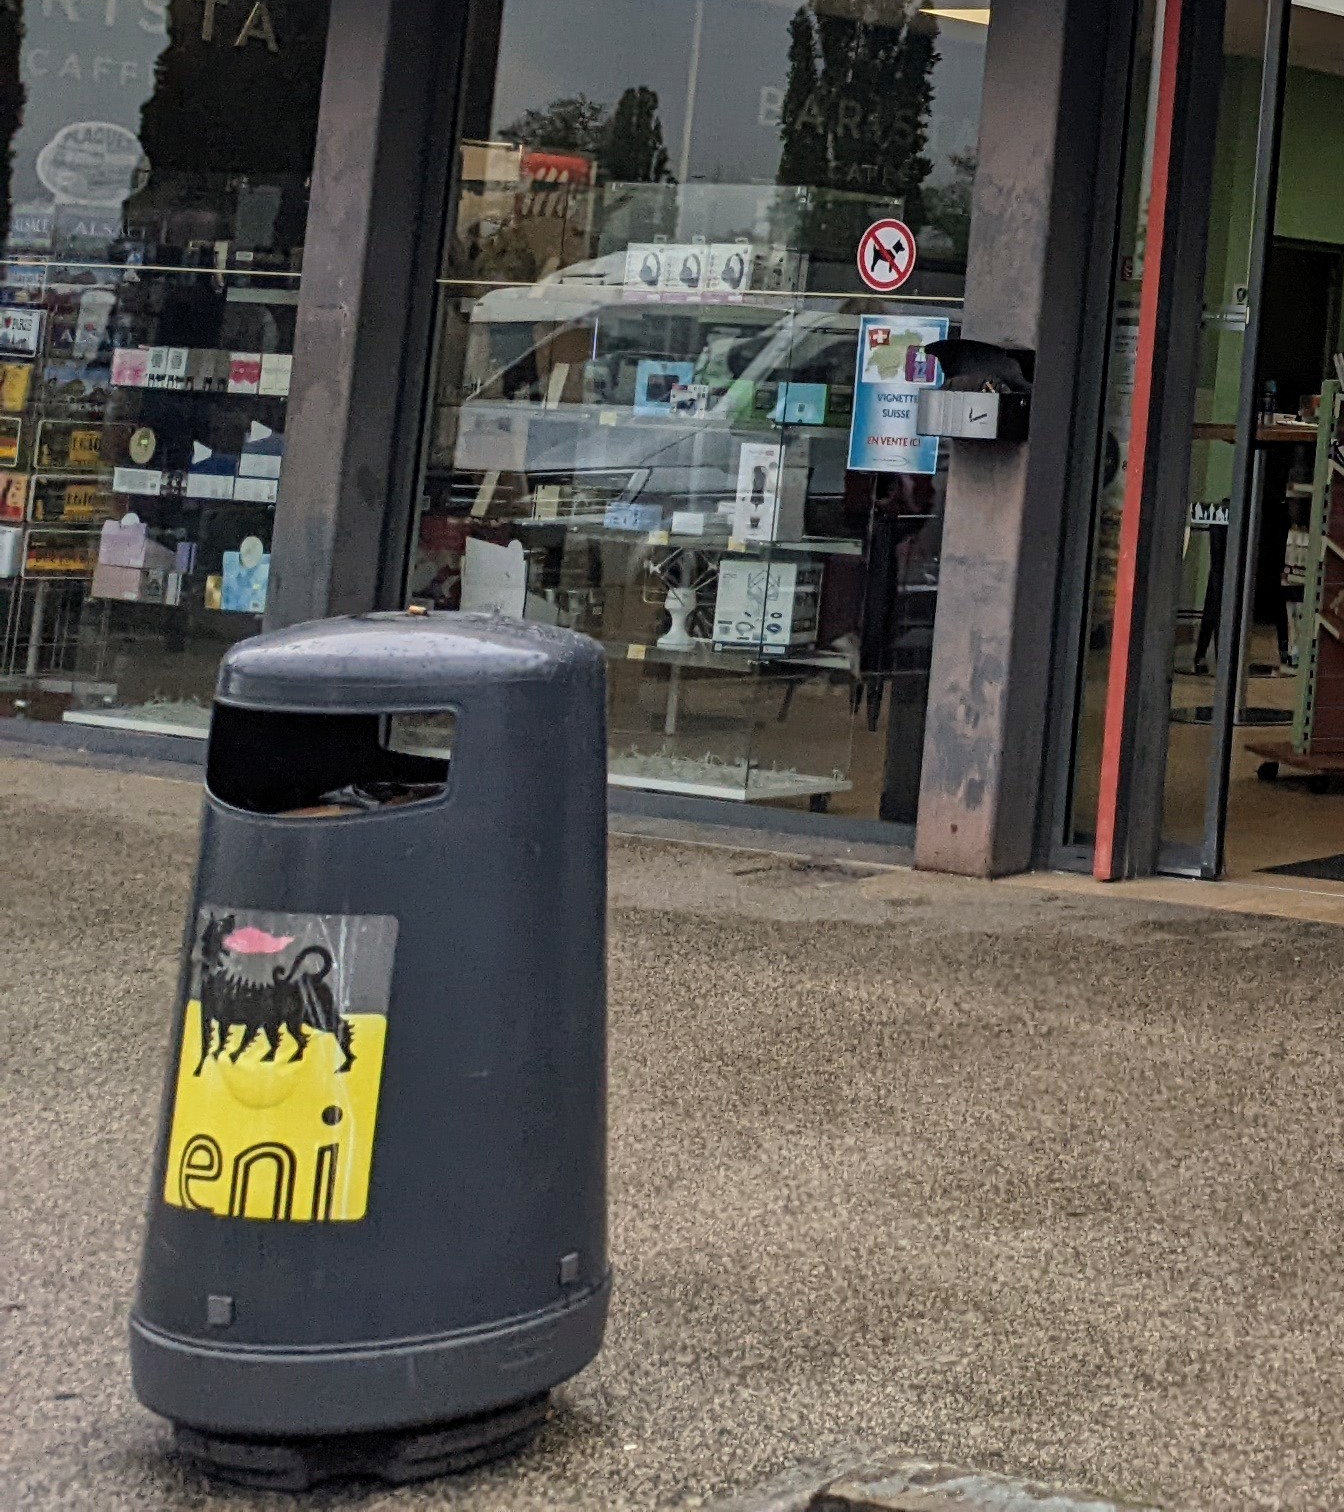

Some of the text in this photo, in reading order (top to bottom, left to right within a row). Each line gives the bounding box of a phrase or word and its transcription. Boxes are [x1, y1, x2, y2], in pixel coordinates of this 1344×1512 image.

[882, 408, 911, 420] SUISSE
[867, 435, 882, 446] EN
[881, 436, 908, 447] VENTE
[178, 1104, 343, 1223] eni
